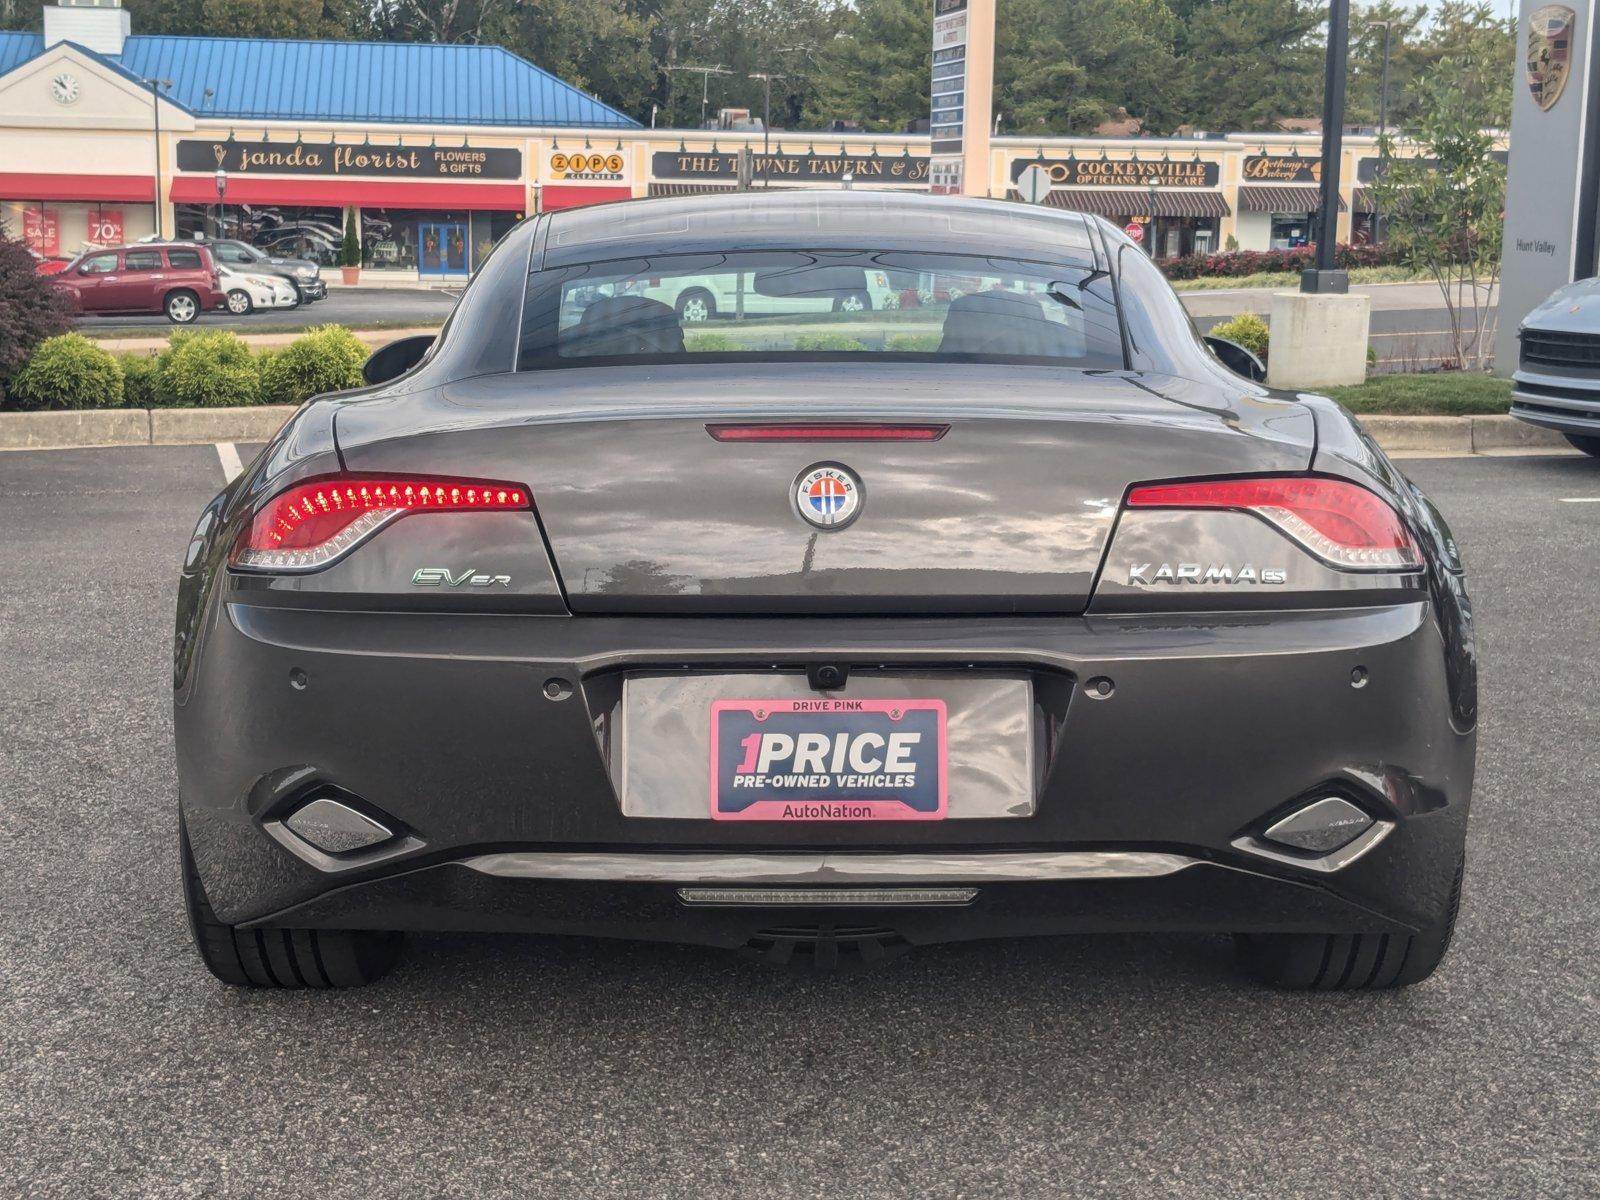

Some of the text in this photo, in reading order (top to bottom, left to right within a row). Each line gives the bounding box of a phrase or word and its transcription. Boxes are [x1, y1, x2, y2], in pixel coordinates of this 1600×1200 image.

[239, 145, 421, 173] janda florist
[434, 151, 486, 163] FLOWERS
[554, 156, 620, 170] ZIPS
[439, 163, 482, 174] & GIFTS
[677, 157, 720, 172] THE
[728, 157, 800, 174] TWNE
[808, 160, 884, 175] TAVERN
[890, 161, 906, 176] &
[1077, 162, 1206, 176] COCKEYSVILLE
[1076, 175, 1205, 186] OPTICIANS & YECARE
[92, 223, 121, 239] 70%
[1516, 239, 1555, 257] Hunt Valley
[802, 471, 852, 493] FISKER
[1128, 563, 1257, 586] KARMA
[792, 701, 863, 711] DRIVE PINK
[735, 732, 922, 774] 1PRICE
[733, 774, 915, 788] PRE-OWNED VEHICLES
[782, 804, 873, 819] AutoNation
